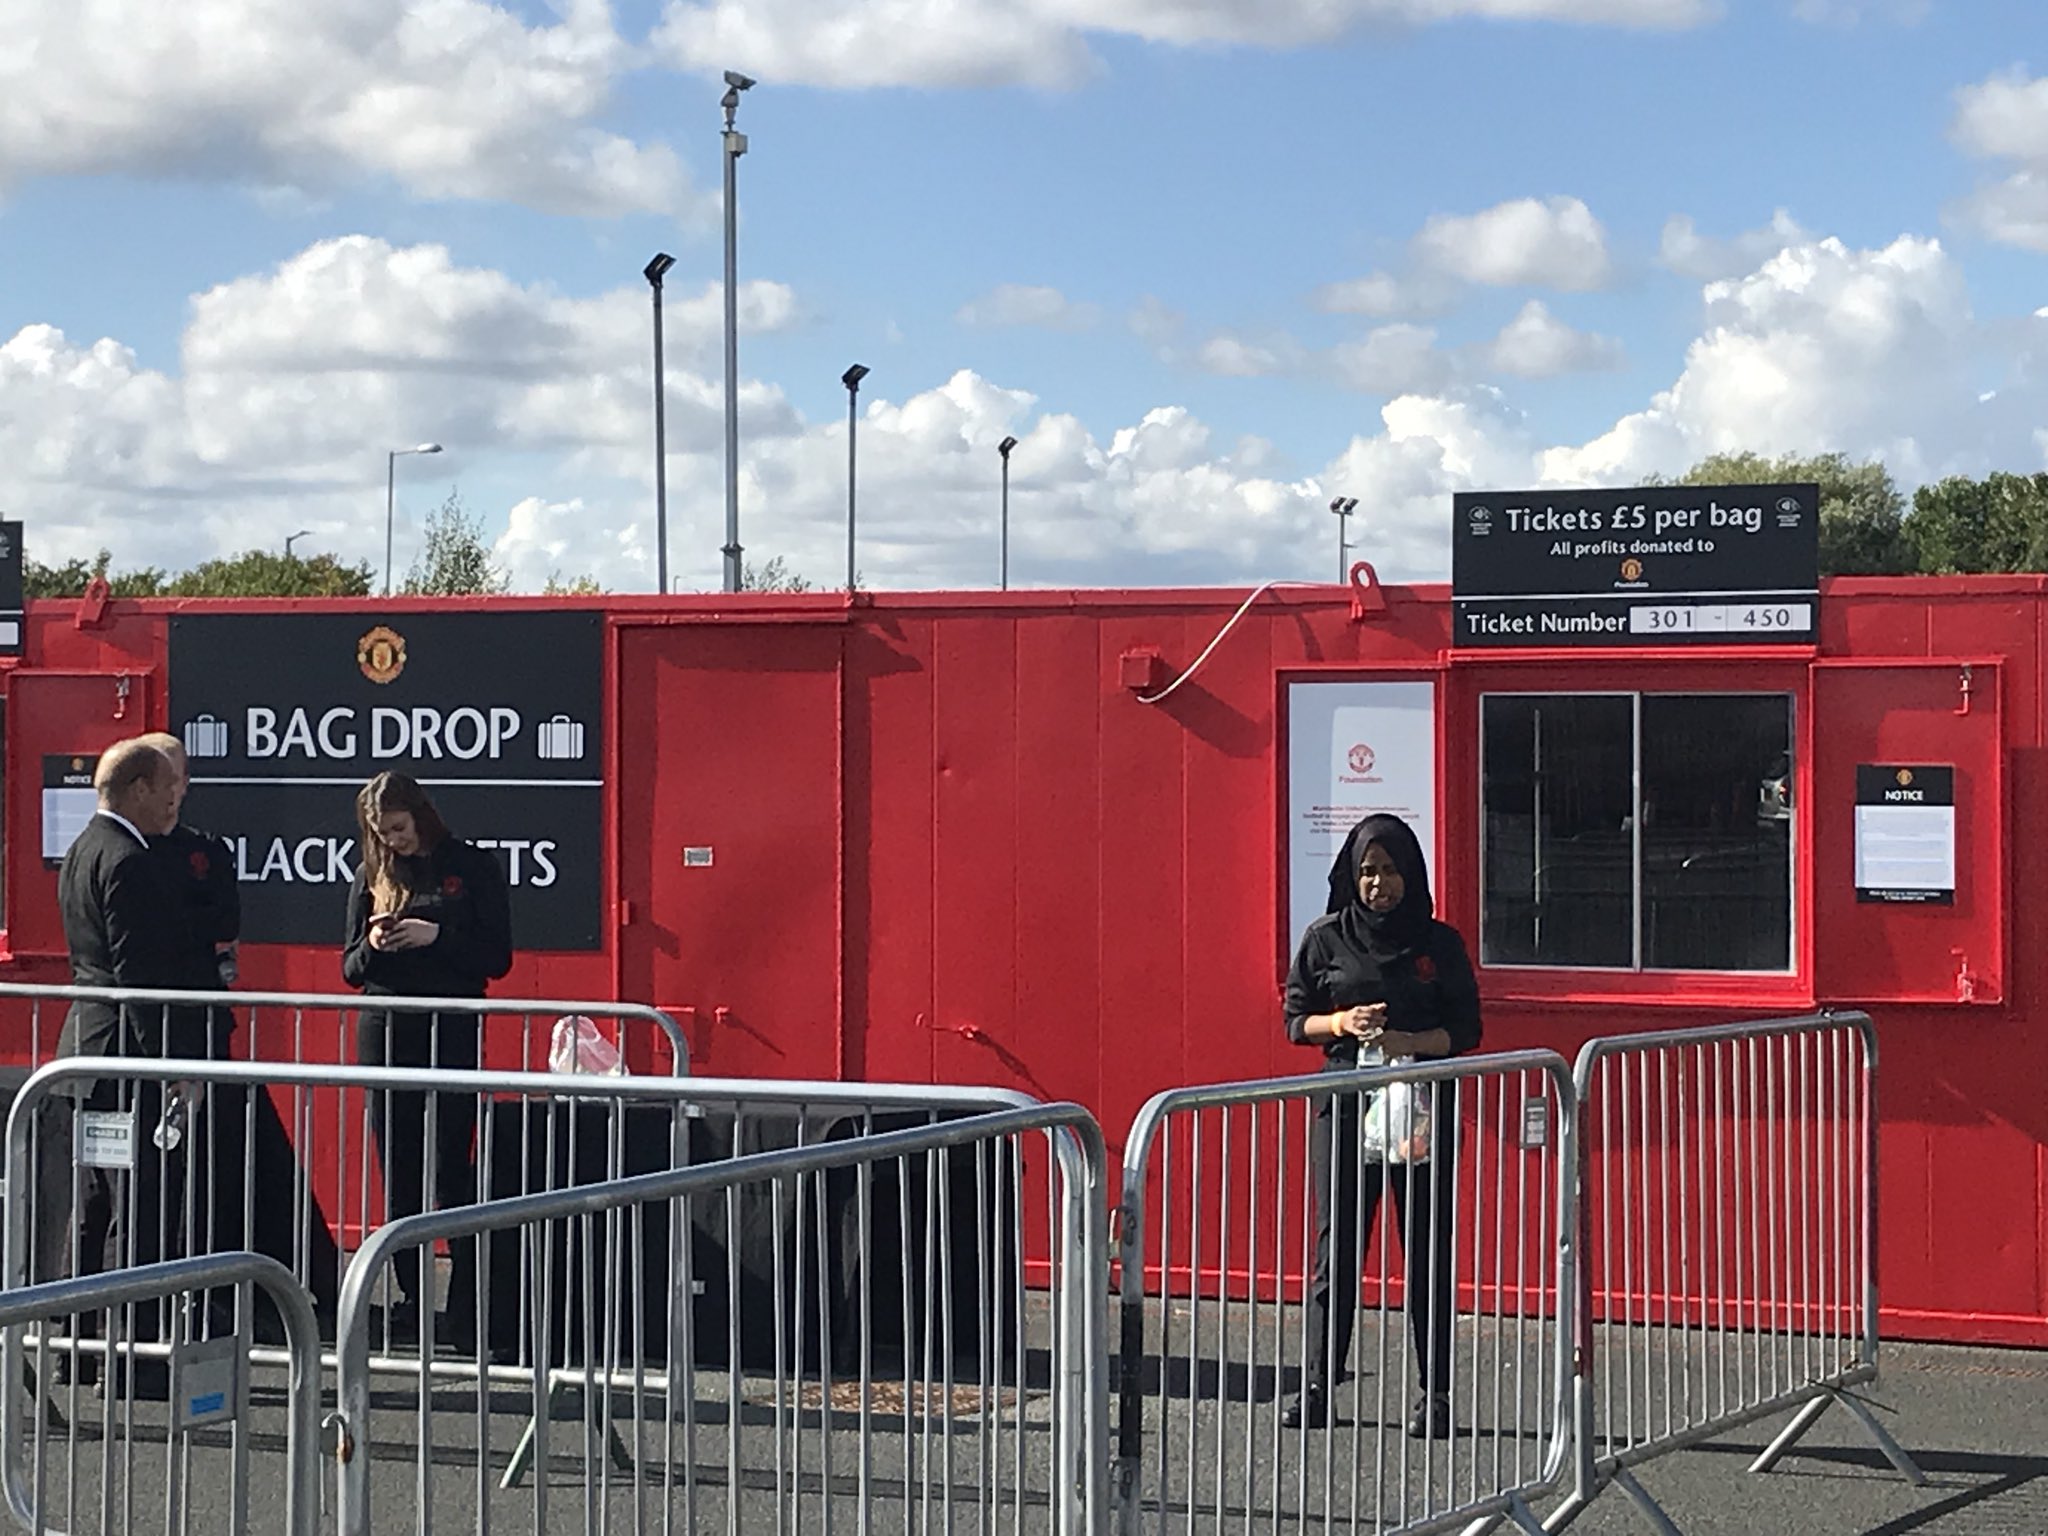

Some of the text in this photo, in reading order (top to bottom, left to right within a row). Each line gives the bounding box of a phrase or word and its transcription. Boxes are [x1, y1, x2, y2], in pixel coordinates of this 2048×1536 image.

[1505, 506, 1602, 531] Tickets
[1610, 505, 1647, 529] £5
[1655, 509, 1701, 535] per
[1710, 502, 1762, 533] bag
[1550, 538, 1715, 559] All profits donated to
[1467, 613, 1534, 633] Ticket
[1541, 612, 1627, 632] Number
[1649, 610, 1691, 628] 301
[1743, 608, 1790, 627] 450
[247, 707, 521, 760] BAG DROP
[1885, 790, 1923, 801] NOTICE
[221, 836, 355, 883] LACK
